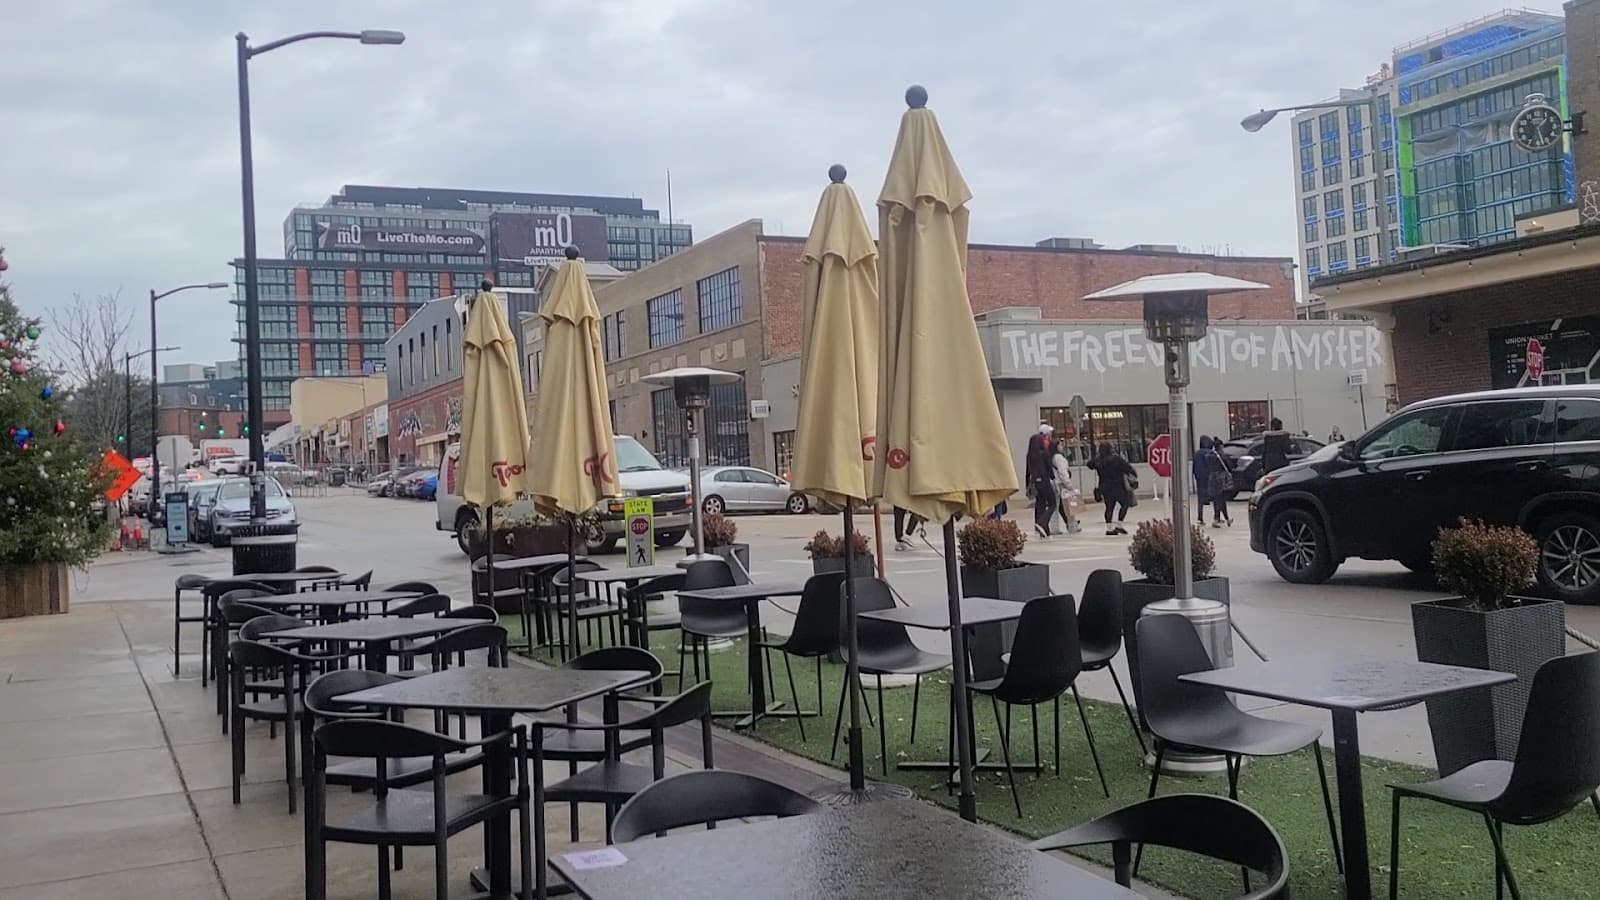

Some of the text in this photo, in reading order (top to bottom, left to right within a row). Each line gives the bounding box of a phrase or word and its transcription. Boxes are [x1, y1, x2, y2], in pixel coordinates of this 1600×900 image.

[376, 231, 474, 245] LiveTheMo.com
[529, 247, 565, 255] APARTME
[1505, 335, 1527, 345] UNION
[1002, 330, 1059, 369] THE
[1063, 328, 1146, 373] FREE
[1230, 332, 1266, 369] OF
[1527, 351, 1542, 368] STOP
[1151, 447, 1171, 465] ST
[632, 523, 648, 531] STOP
